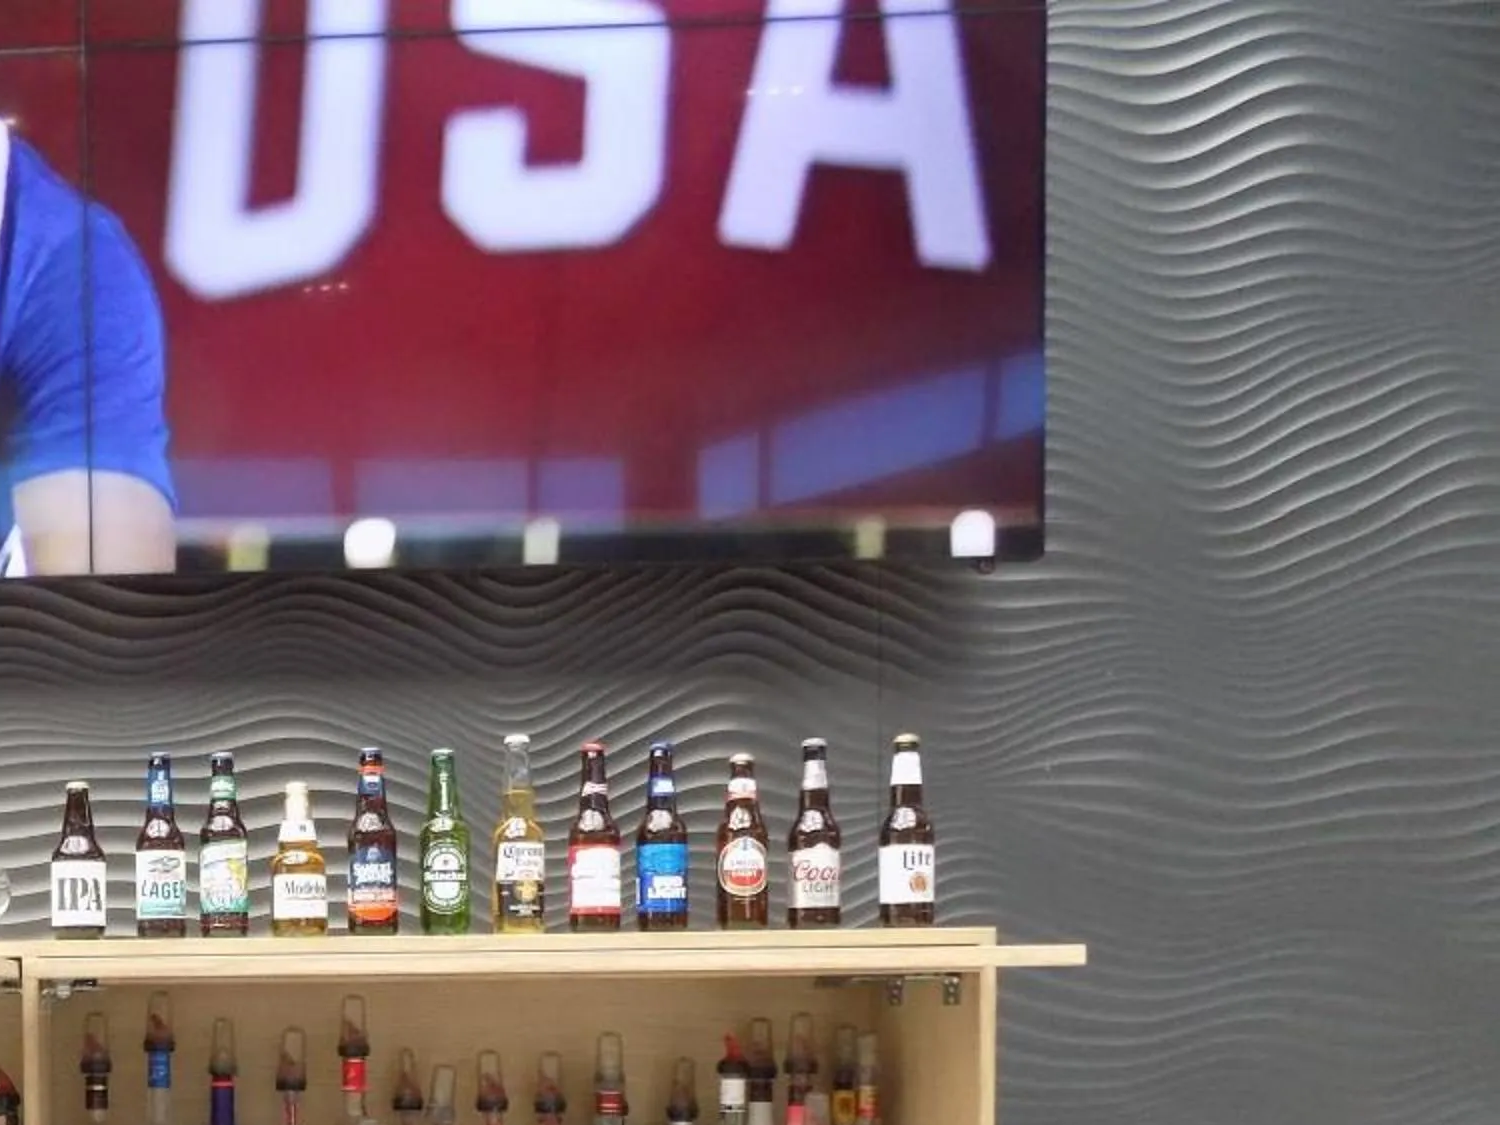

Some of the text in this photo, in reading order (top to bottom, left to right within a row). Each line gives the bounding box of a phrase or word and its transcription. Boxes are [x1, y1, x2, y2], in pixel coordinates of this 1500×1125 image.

[165, 0, 993, 301] USA
[794, 861, 837, 881] Coo
[902, 850, 932, 871] Lite
[57, 877, 102, 911] IPA
[803, 882, 835, 893] LIGH
